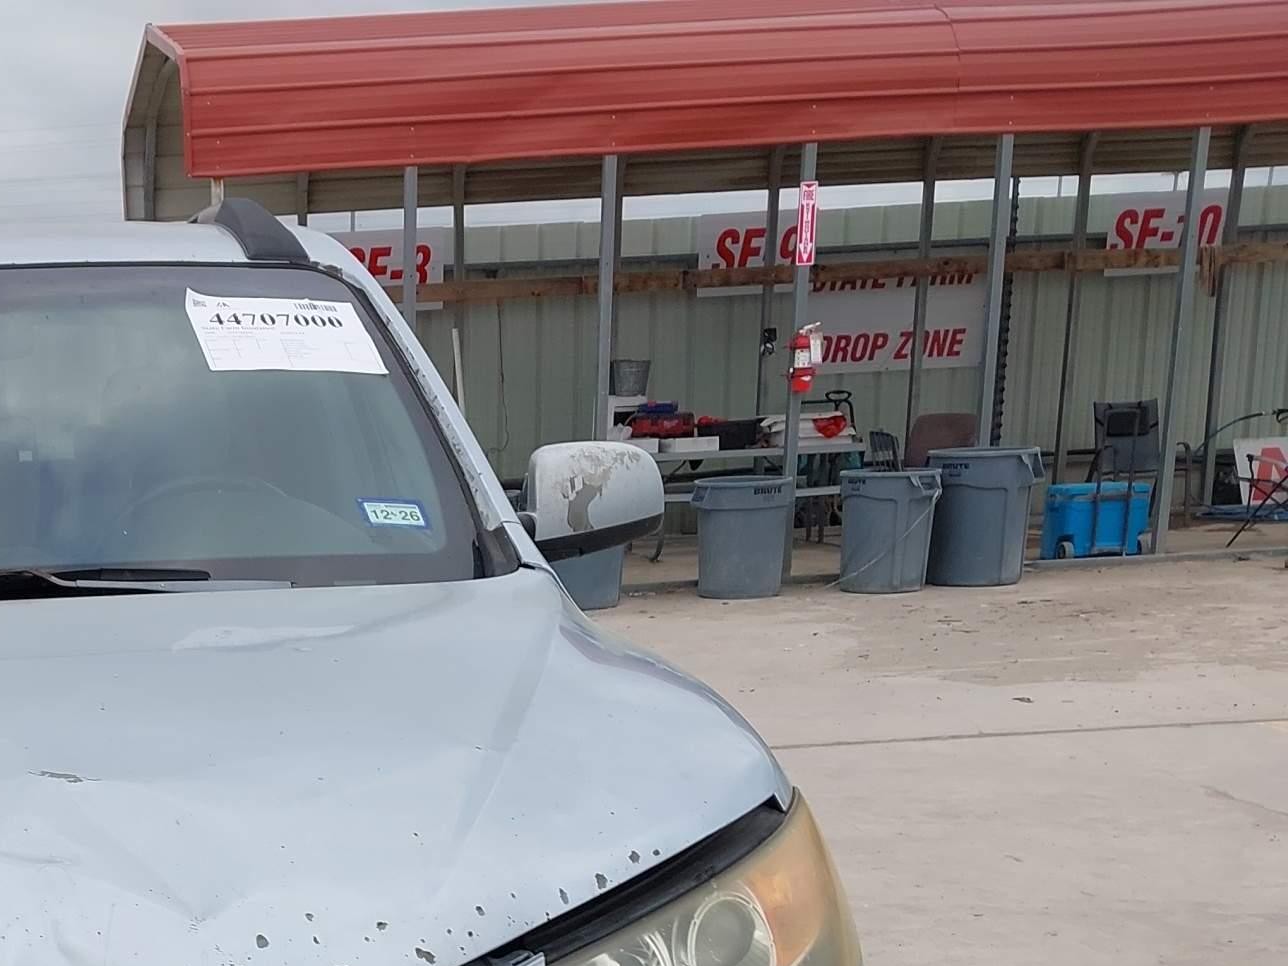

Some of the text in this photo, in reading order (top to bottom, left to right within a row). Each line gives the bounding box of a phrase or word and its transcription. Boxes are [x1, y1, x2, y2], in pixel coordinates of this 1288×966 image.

[1110, 205, 1222, 250] SF-0
[209, 312, 343, 329] 44707000
[822, 333, 888, 364] DROP
[893, 328, 967, 361] ZNE
